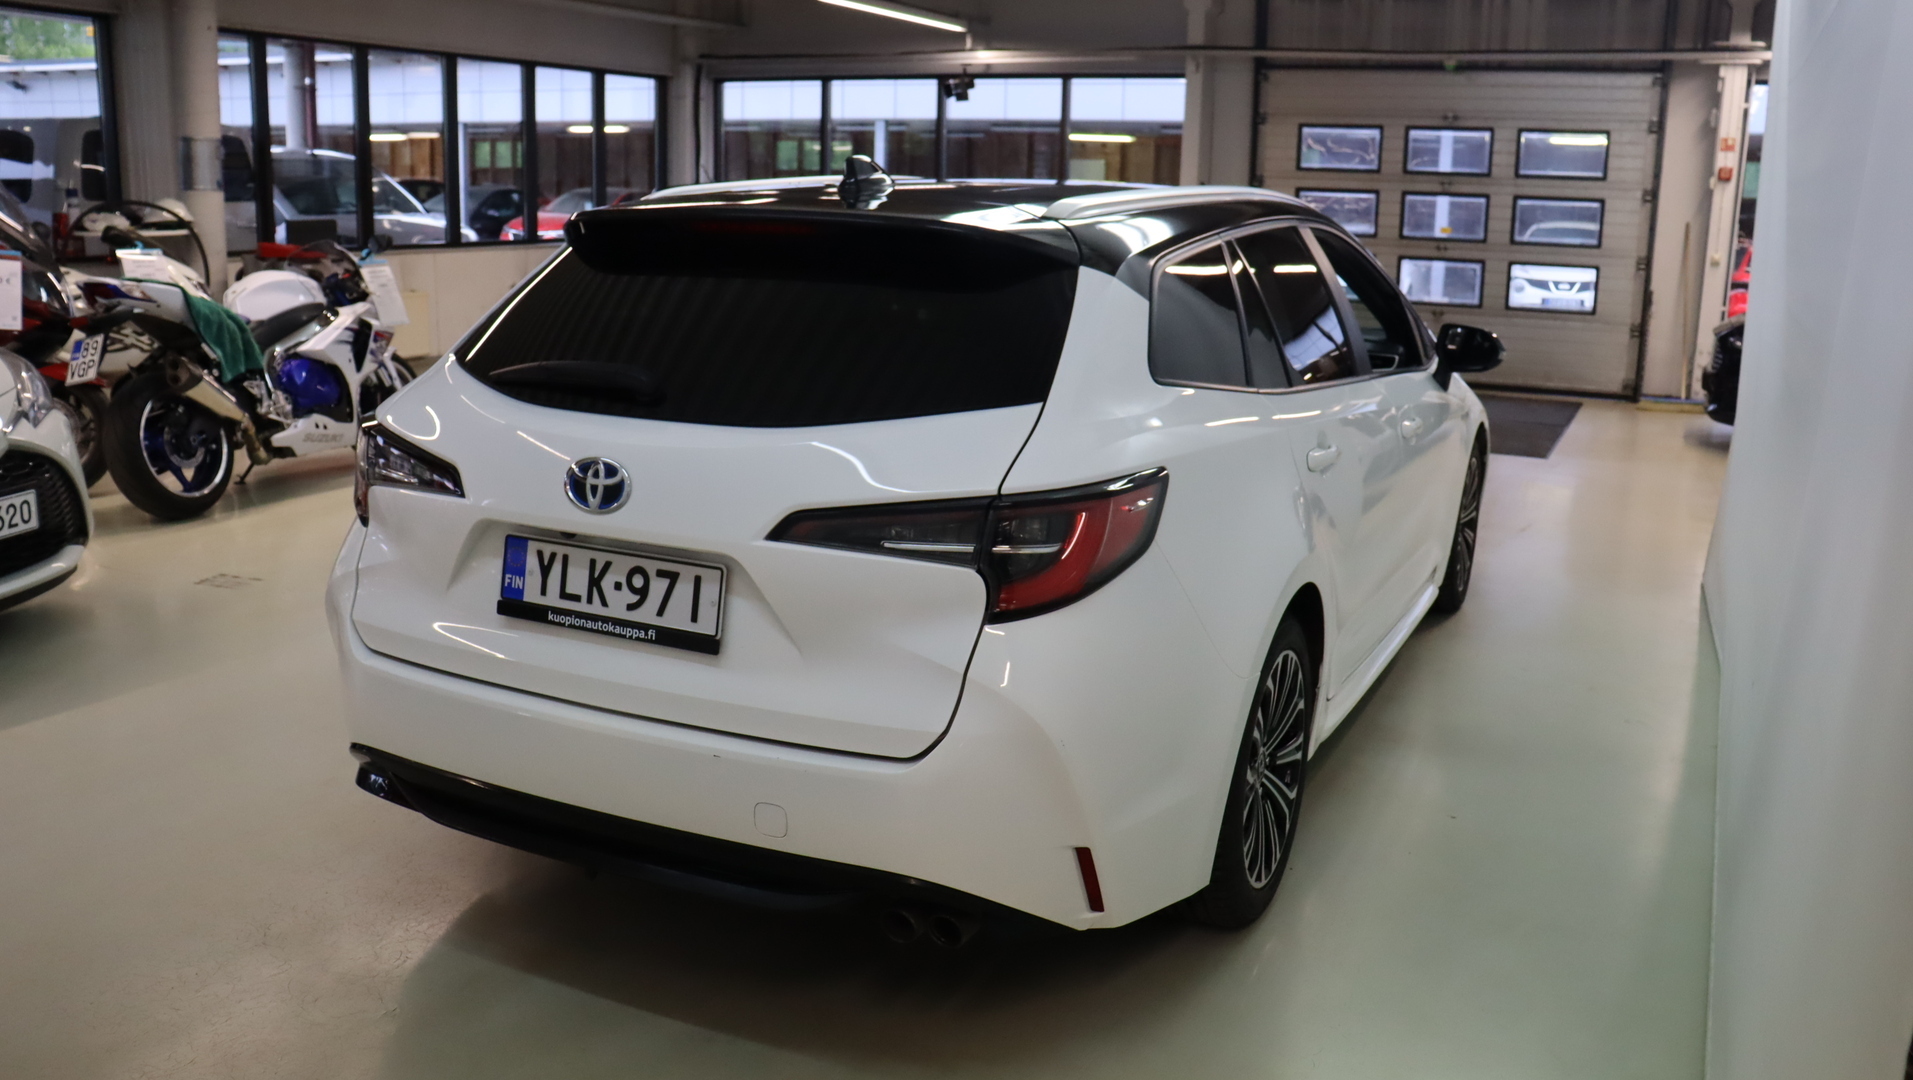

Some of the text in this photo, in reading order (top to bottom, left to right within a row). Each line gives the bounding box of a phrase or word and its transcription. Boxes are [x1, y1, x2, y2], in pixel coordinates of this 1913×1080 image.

[81, 340, 99, 359] 89
[70, 360, 95, 380] VGP
[504, 574, 524, 590] FIN
[536, 549, 702, 624] YLK-971
[548, 610, 656, 641] kuopionautokauppa.fi
